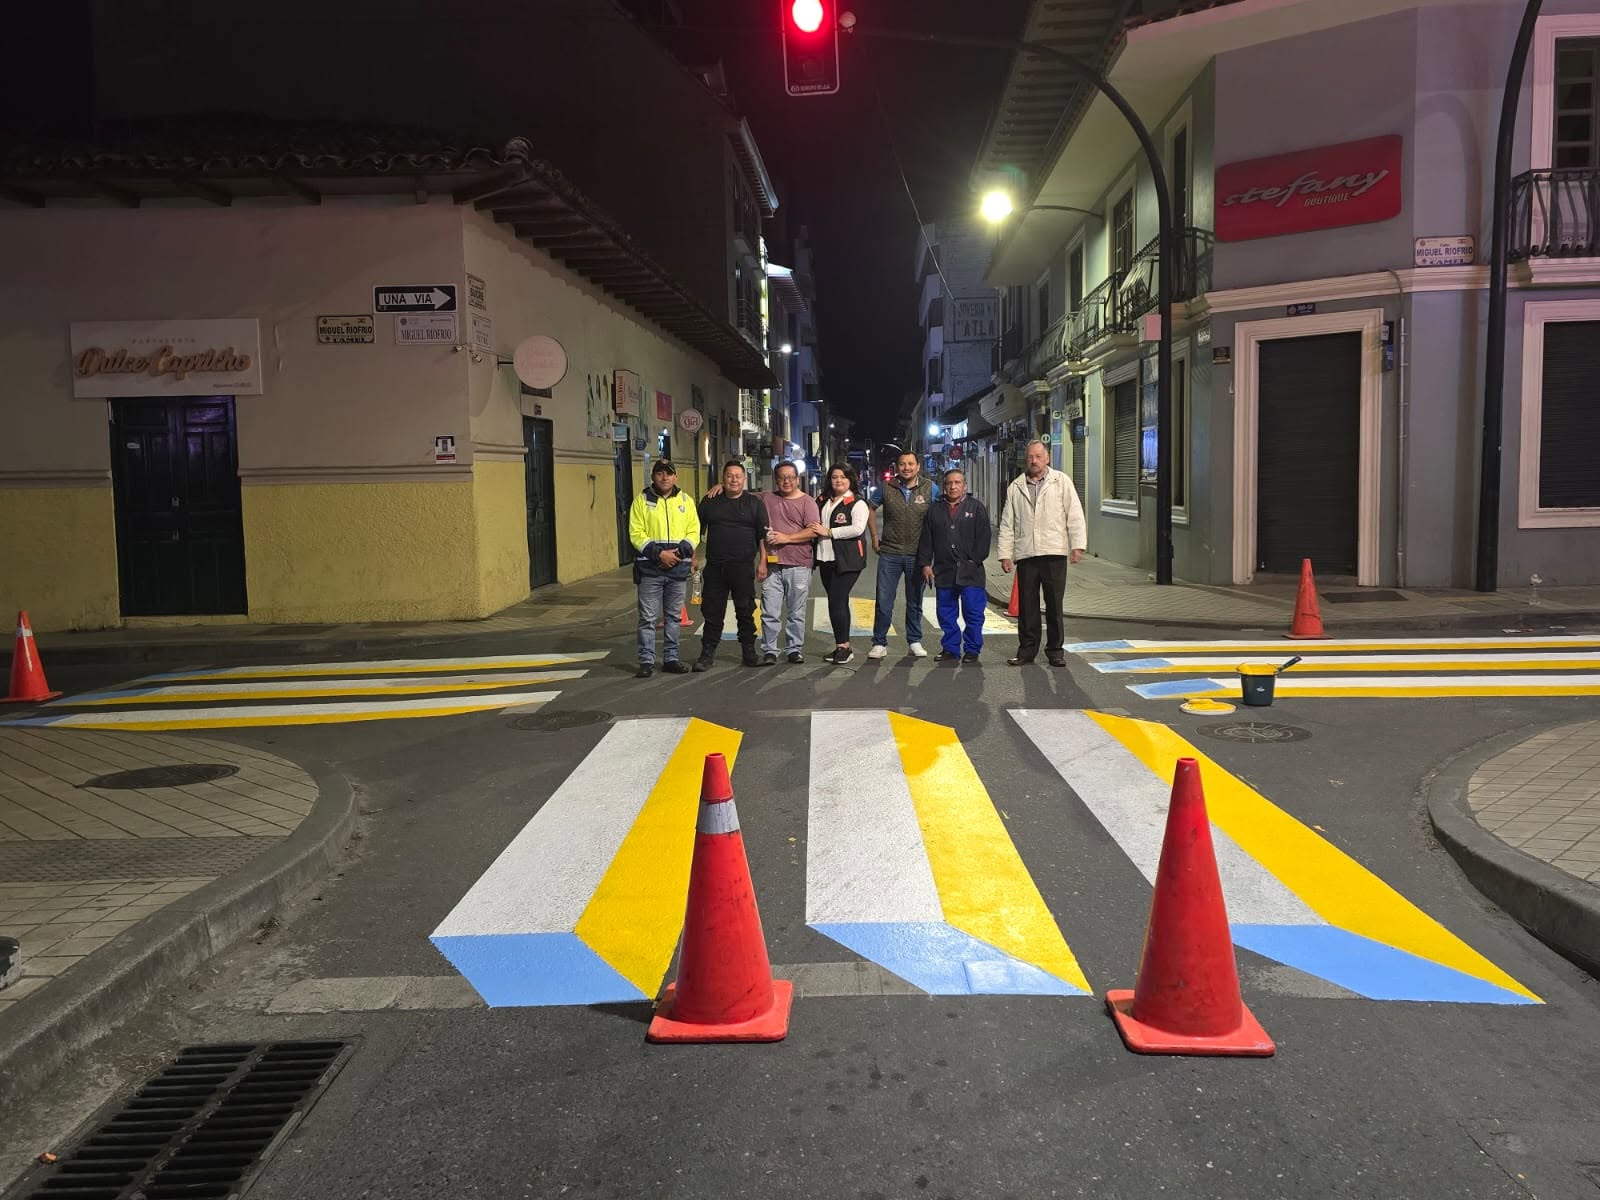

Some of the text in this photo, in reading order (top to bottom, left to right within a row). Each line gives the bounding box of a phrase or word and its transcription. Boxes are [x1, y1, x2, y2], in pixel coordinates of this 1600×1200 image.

[1221, 169, 1391, 208] stefany
[1304, 192, 1351, 207] BOUTIQUE
[1416, 246, 1473, 257] MIGUEL RIOFRIO
[383, 293, 433, 305] UNA VIA
[470, 287, 484, 302] SUCRE
[319, 325, 373, 335] MIGUEL RIOFRIO
[401, 328, 452, 341] MIGUEL RIOFRIO
[75, 347, 149, 378] Dulce
